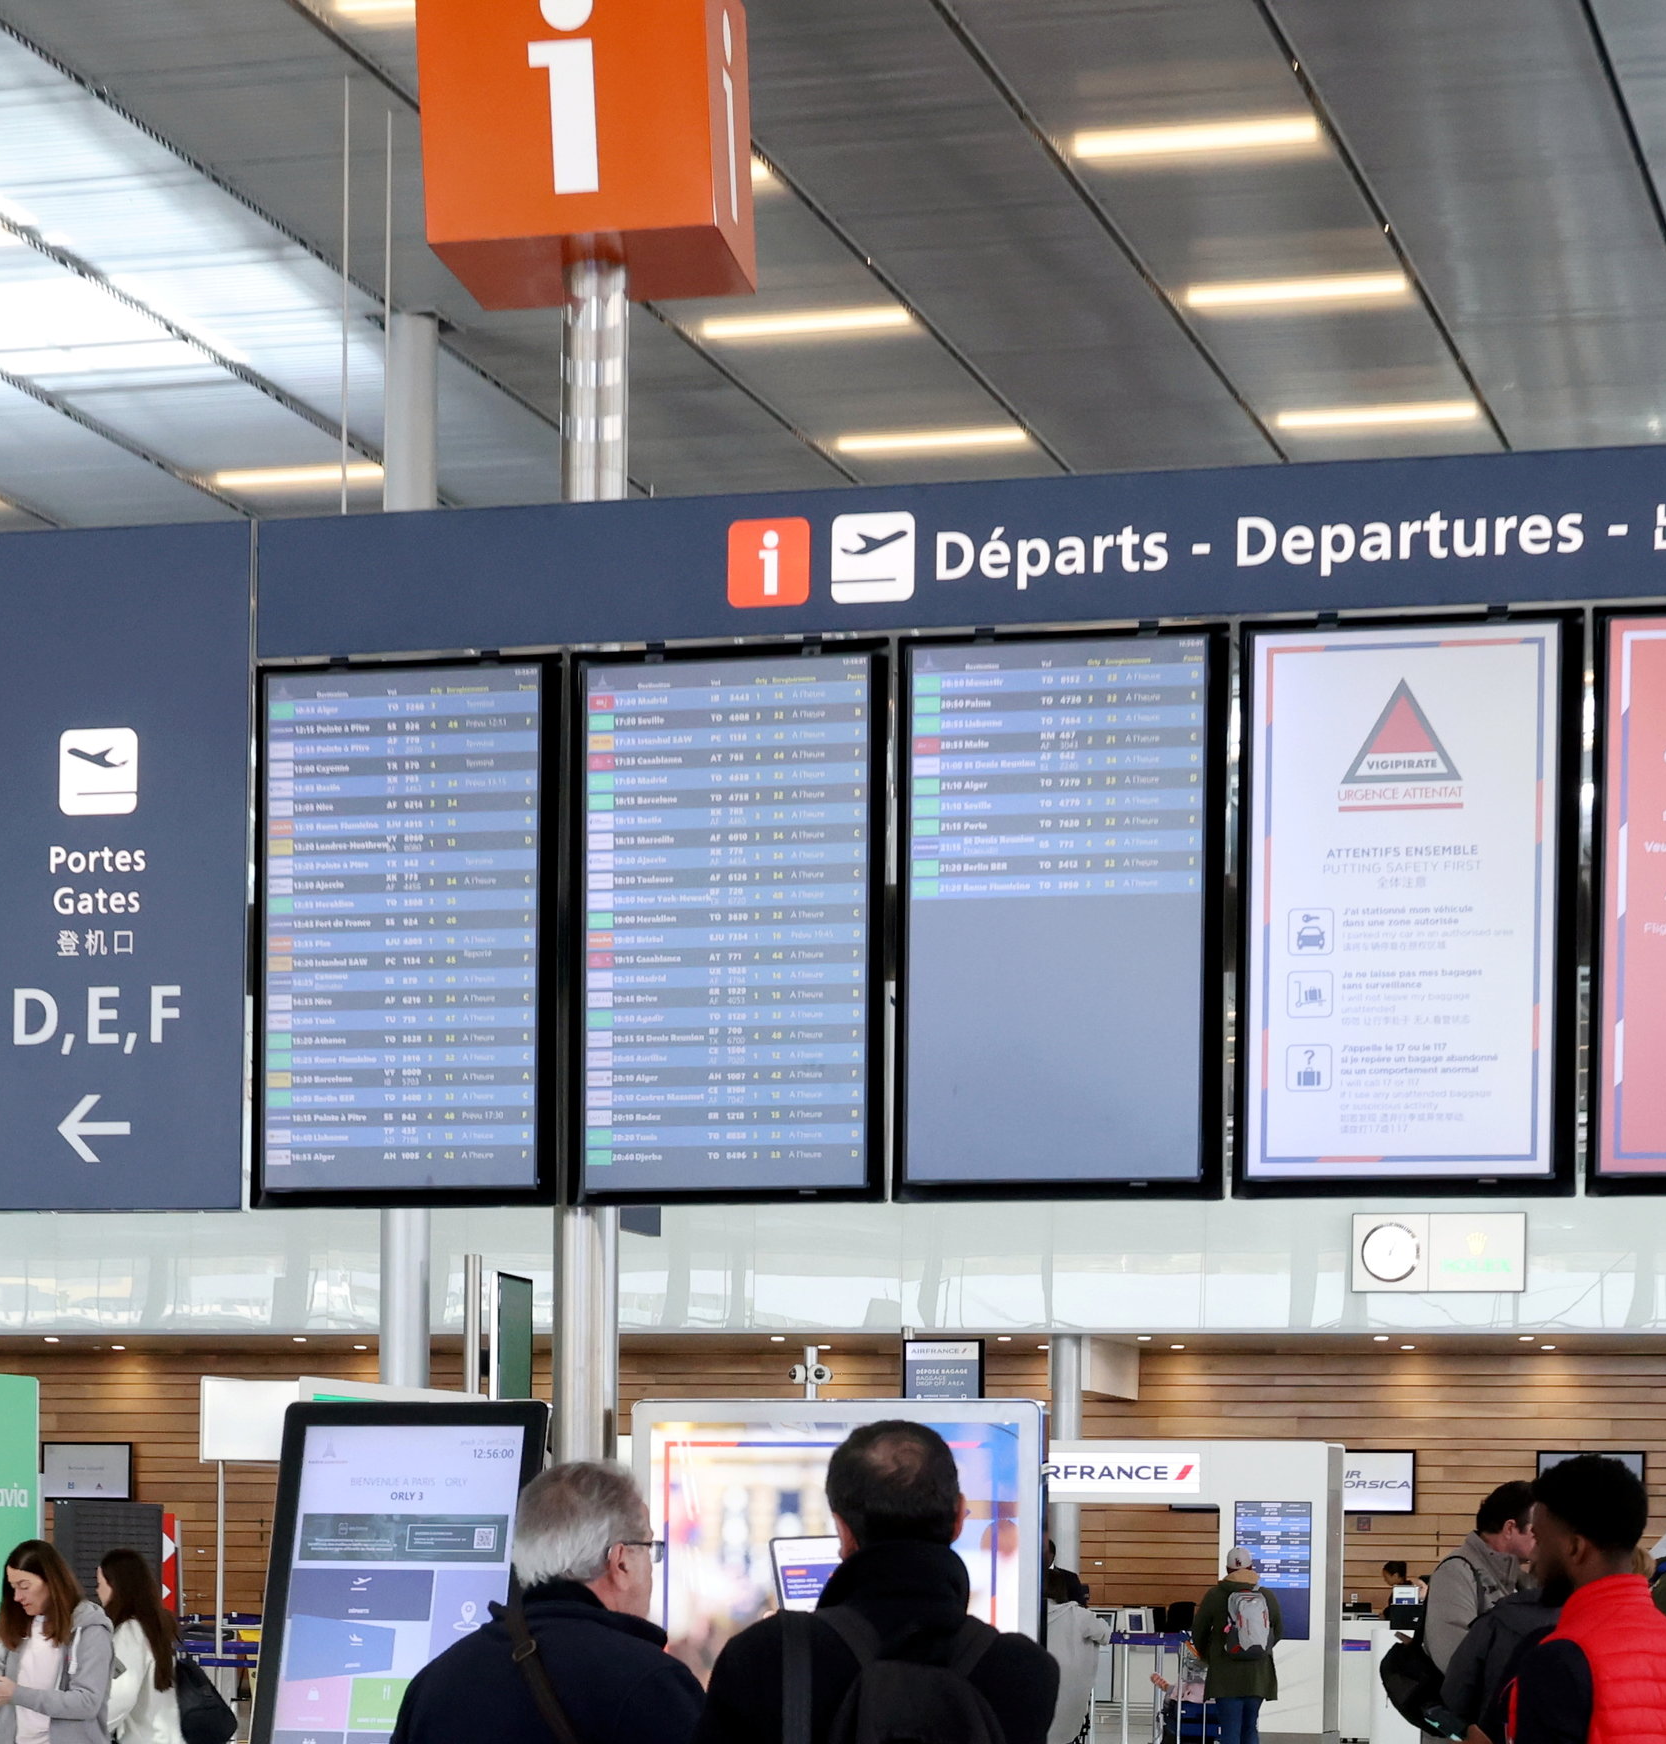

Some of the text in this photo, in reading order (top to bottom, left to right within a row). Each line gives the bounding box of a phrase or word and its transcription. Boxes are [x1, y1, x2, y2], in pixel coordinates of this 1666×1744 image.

[935, 526, 1169, 589] Départs
[1236, 511, 1584, 576] Departures
[1366, 759, 1437, 770] VIGIPIRATE
[964, 780, 988, 791] Alger
[1337, 786, 1463, 801] URGENCE ATTENTAT
[1326, 844, 1478, 859] ATTENTIFS ENSEMBLE
[49, 846, 146, 874] Portes
[1323, 860, 1481, 875] PUTTING SAFETY FIRST
[53, 887, 140, 915] Gates
[56, 928, 134, 956] 登机口
[13, 985, 181, 1055] D,E,F
[636, 1073, 658, 1083] Alger
[473, 1449, 514, 1459] 12:56:00
[1048, 1465, 1169, 1481] RFRANCE
[1345, 1470, 1361, 1479] IR
[350, 1477, 400, 1486] BIENVENUE
[412, 1477, 436, 1486] PARIS
[445, 1476, 467, 1486] ORLY
[1344, 1480, 1411, 1489] ORSICA
[390, 1491, 423, 1501] ORLY 3
